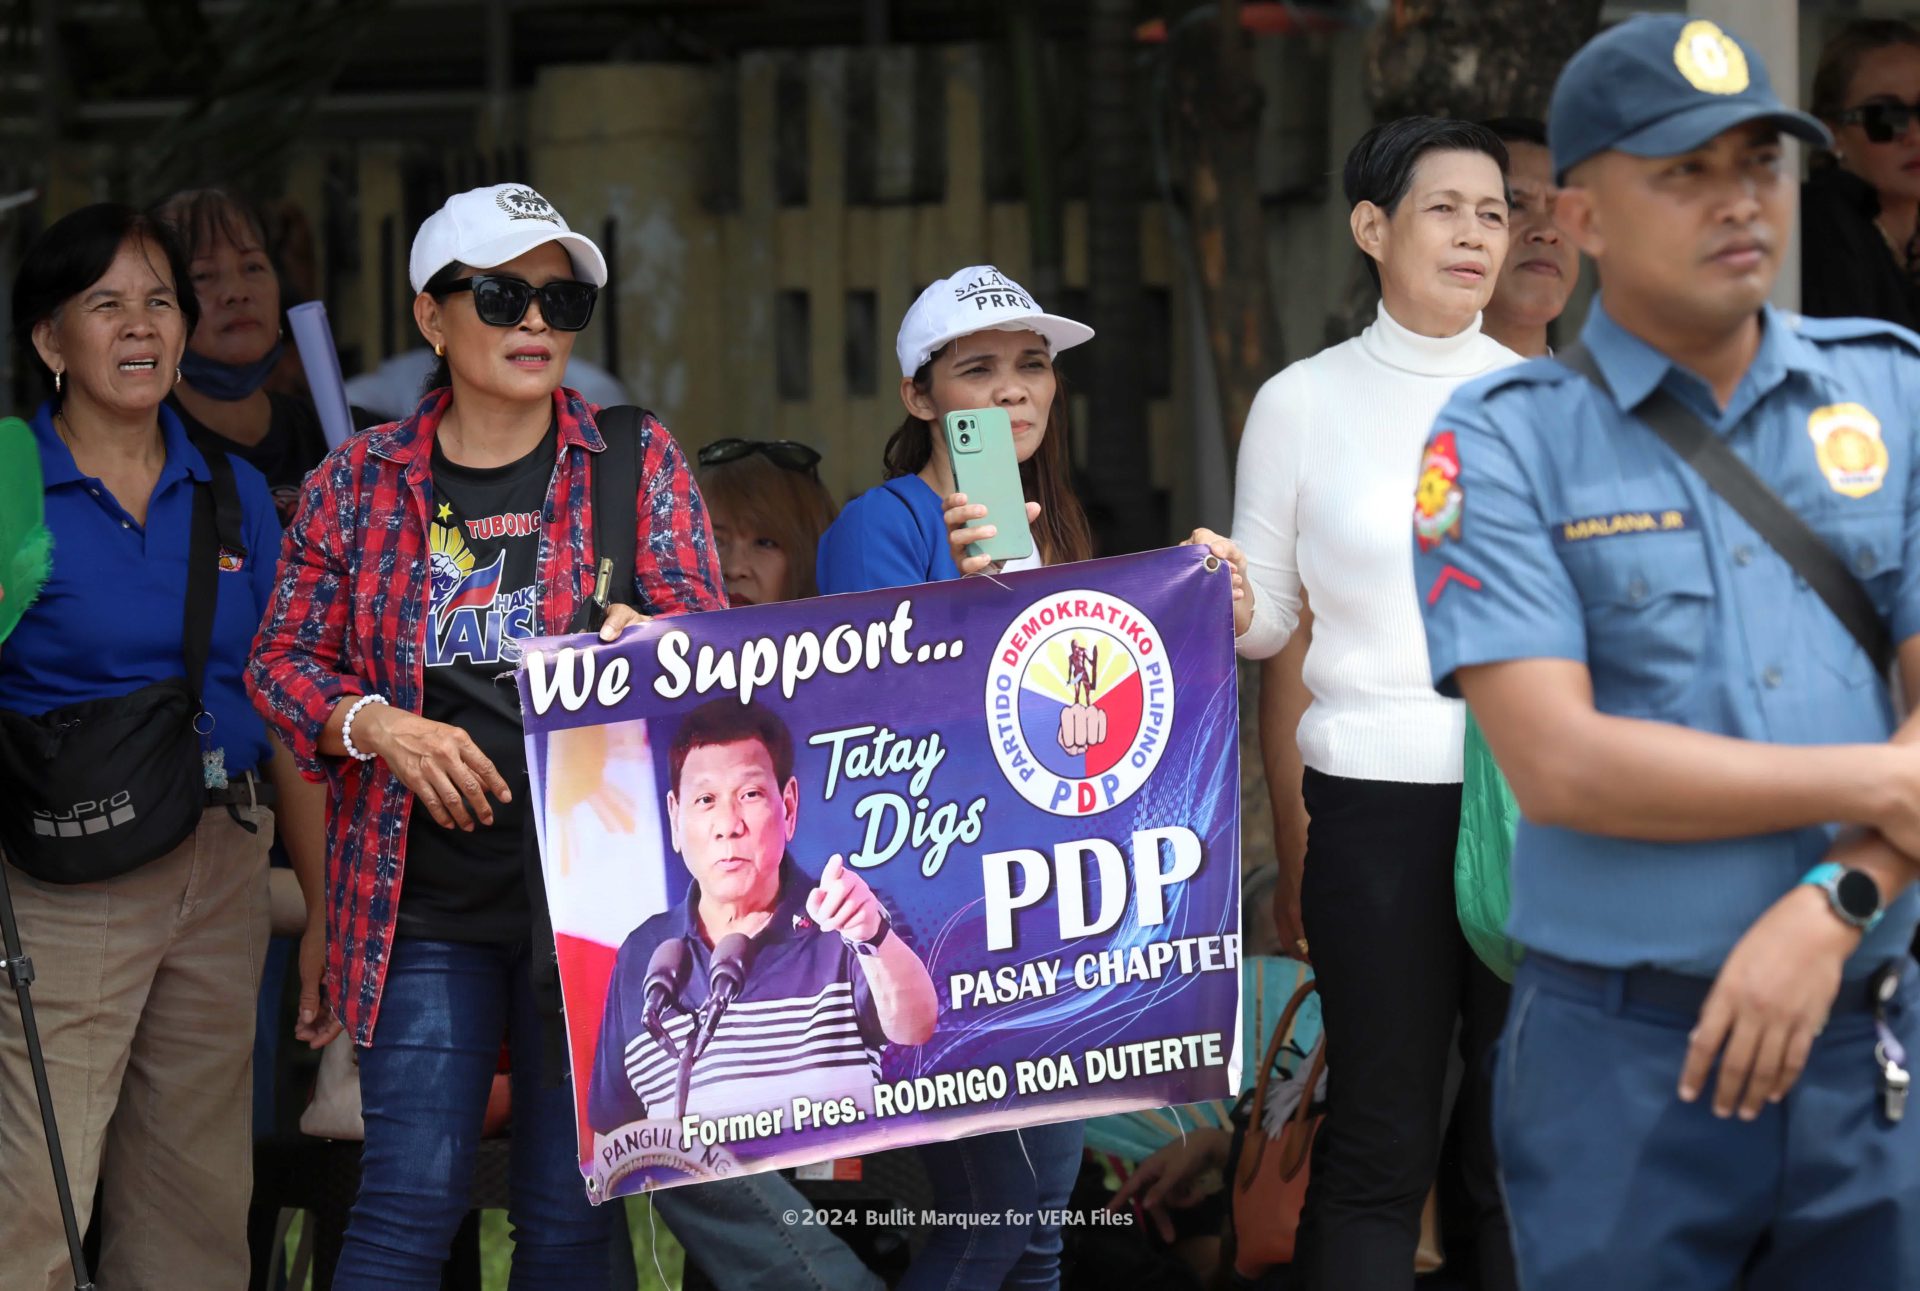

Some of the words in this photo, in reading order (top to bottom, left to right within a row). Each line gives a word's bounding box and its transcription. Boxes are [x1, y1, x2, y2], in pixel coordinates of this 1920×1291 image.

[975, 293, 1030, 310] PRRD
[465, 510, 541, 540] TUBONG
[526, 648, 631, 715] We
[653, 600, 963, 705] Support...
[1002, 600, 1153, 667] DEMOKRATIKO
[996, 674, 1036, 782] PARTIDO
[1131, 661, 1164, 768] PILIPINO
[809, 726, 946, 800] Tatay
[1049, 774, 1120, 813] PDP
[849, 793, 987, 877] Digs
[982, 825, 1202, 952] PDP
[950, 959, 1061, 1010] PASAY
[682, 1111, 784, 1149] Former
[792, 1096, 865, 1131] Pres.
[873, 1066, 1007, 1118] RODRIGO
[1016, 1054, 1079, 1095] ROA
[1085, 1032, 1224, 1083] DUTERTE
